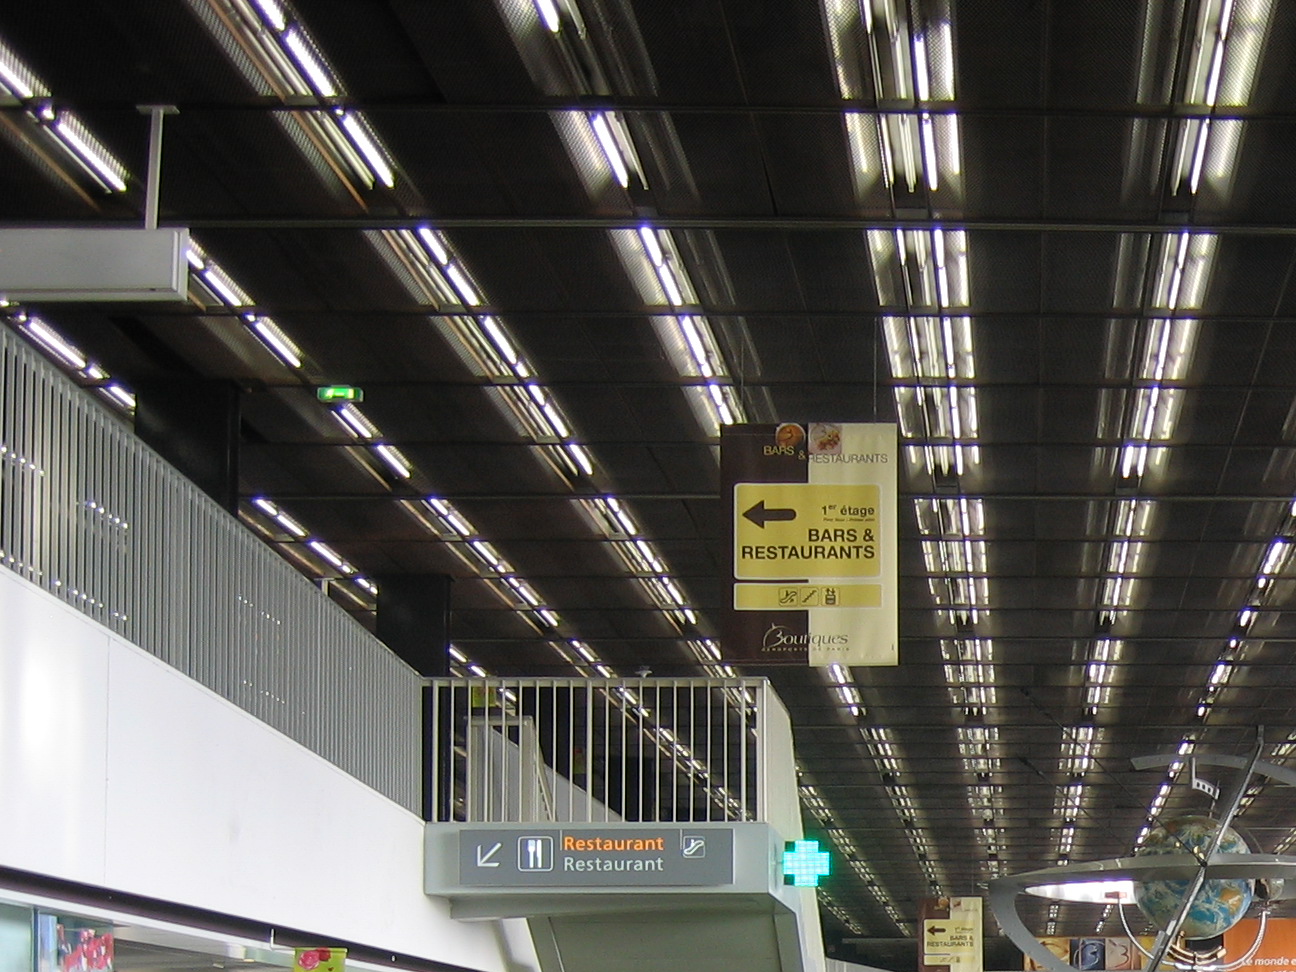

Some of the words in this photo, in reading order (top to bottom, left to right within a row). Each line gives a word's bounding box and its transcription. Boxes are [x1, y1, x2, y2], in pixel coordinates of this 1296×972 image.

[763, 445, 795, 456] BARS
[808, 453, 888, 464] RESTAURANTS
[840, 504, 875, 518] étage
[808, 528, 858, 543] BARS
[862, 528, 875, 543] &
[741, 545, 875, 560] RESTAURANTS
[563, 836, 664, 851] Restaurant
[563, 856, 664, 872] Restaurant
[1254, 956, 1290, 966] monde
